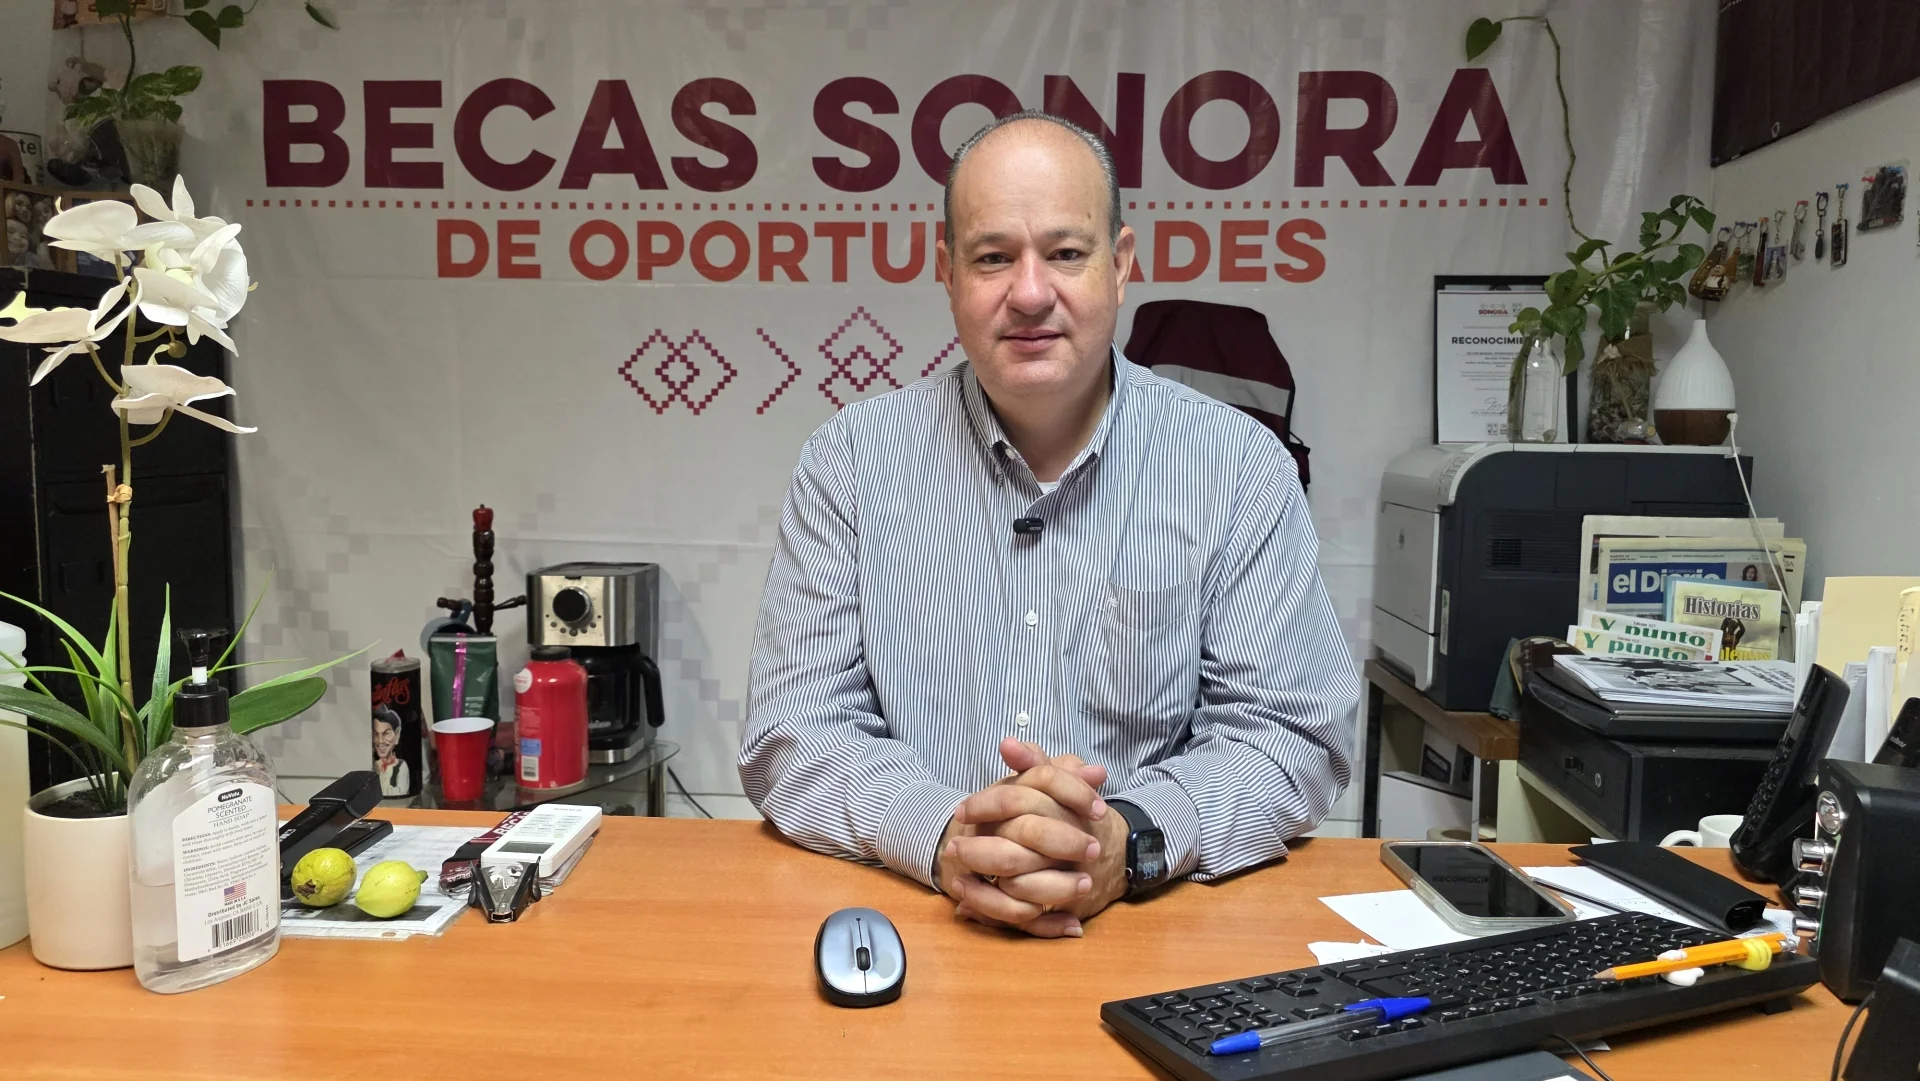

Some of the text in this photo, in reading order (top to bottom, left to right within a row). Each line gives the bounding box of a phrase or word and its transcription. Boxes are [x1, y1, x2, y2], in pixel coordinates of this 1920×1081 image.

[263, 68, 1528, 192] BECAS SONORA
[436, 218, 1327, 283] DE OPORTUDES
[1452, 336, 1524, 345] RECONOCIMIE
[1612, 569, 1637, 593] el
[1685, 596, 1760, 620] Historias
[1583, 632, 1689, 660] Y punto
[207, 796, 252, 814] POMEGRANATE
[215, 805, 247, 818] SCENTED
[213, 813, 250, 828] HAND SOAP
[208, 906, 235, 917] Distributed
